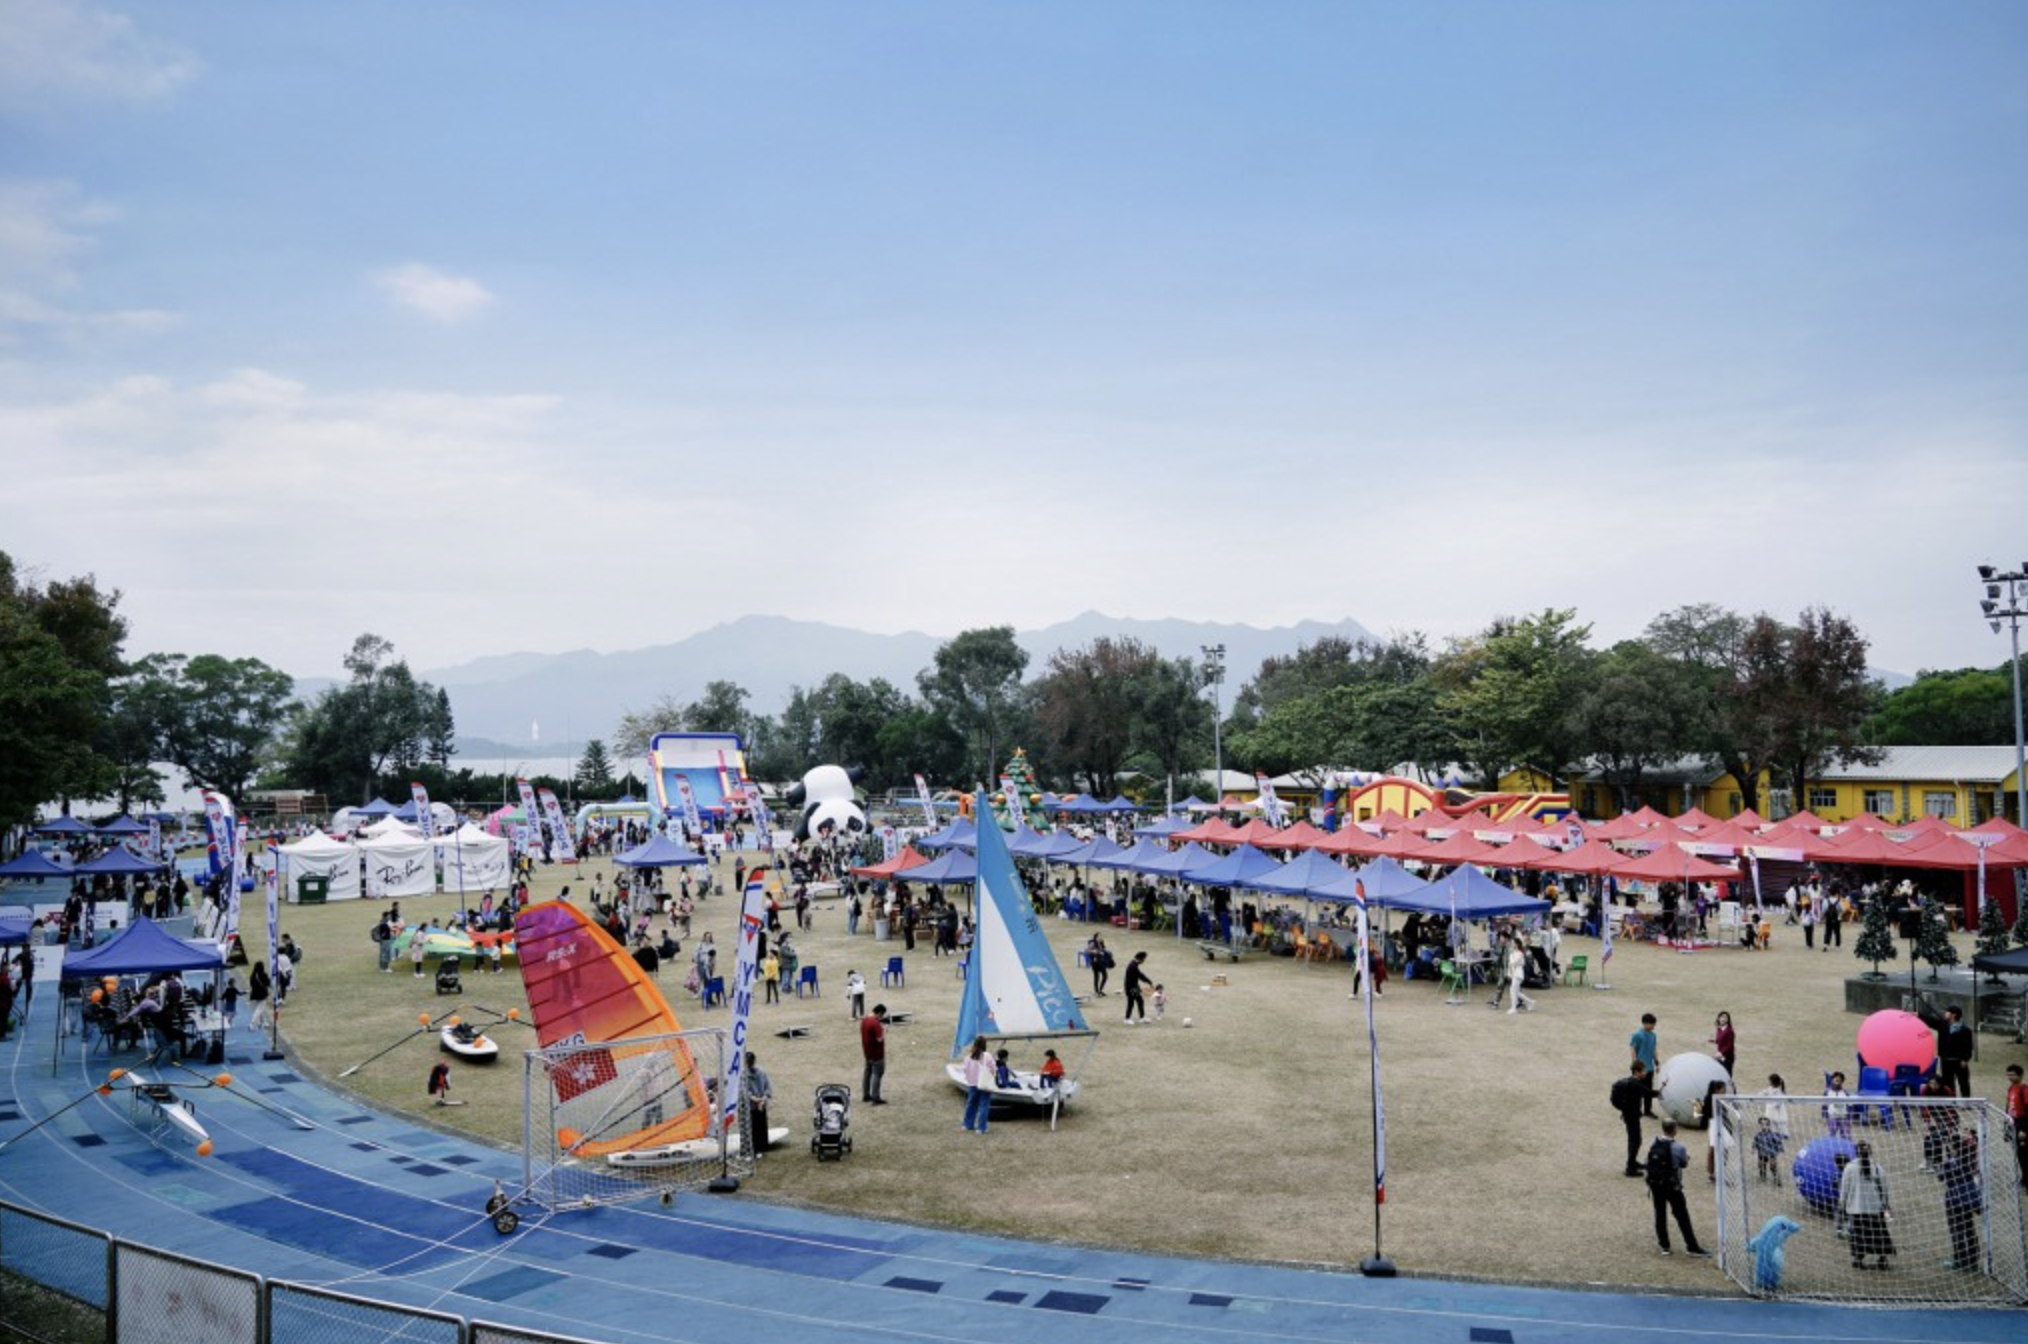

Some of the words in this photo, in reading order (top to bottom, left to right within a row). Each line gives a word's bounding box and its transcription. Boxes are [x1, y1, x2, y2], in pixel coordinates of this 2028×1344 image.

[552, 815, 569, 850] YMCA
[376, 860, 424, 885] Ray-Ban
[728, 960, 755, 1076] YMCA
